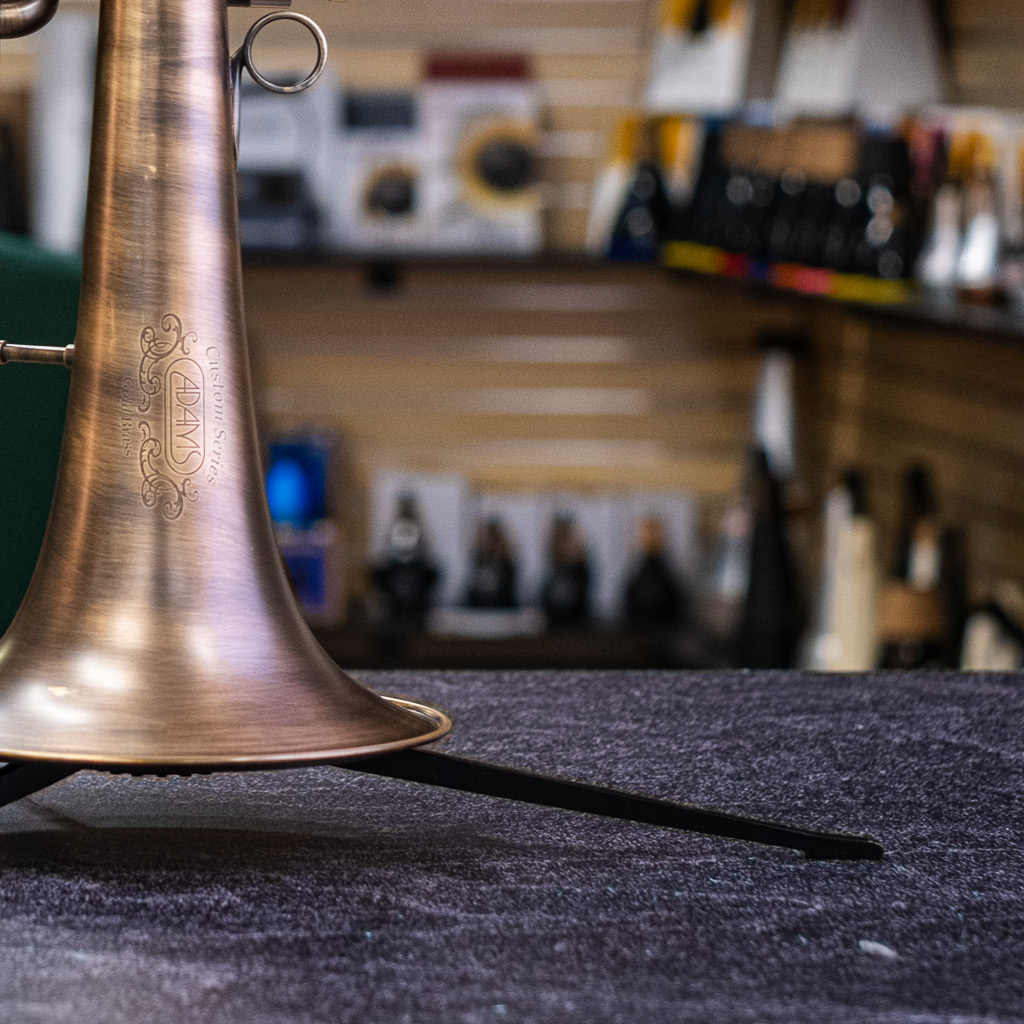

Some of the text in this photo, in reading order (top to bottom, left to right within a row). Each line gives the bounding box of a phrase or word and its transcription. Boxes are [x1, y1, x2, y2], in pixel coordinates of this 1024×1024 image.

[170, 371, 201, 465] ADAMS
[206, 346, 226, 485] Custom Series
